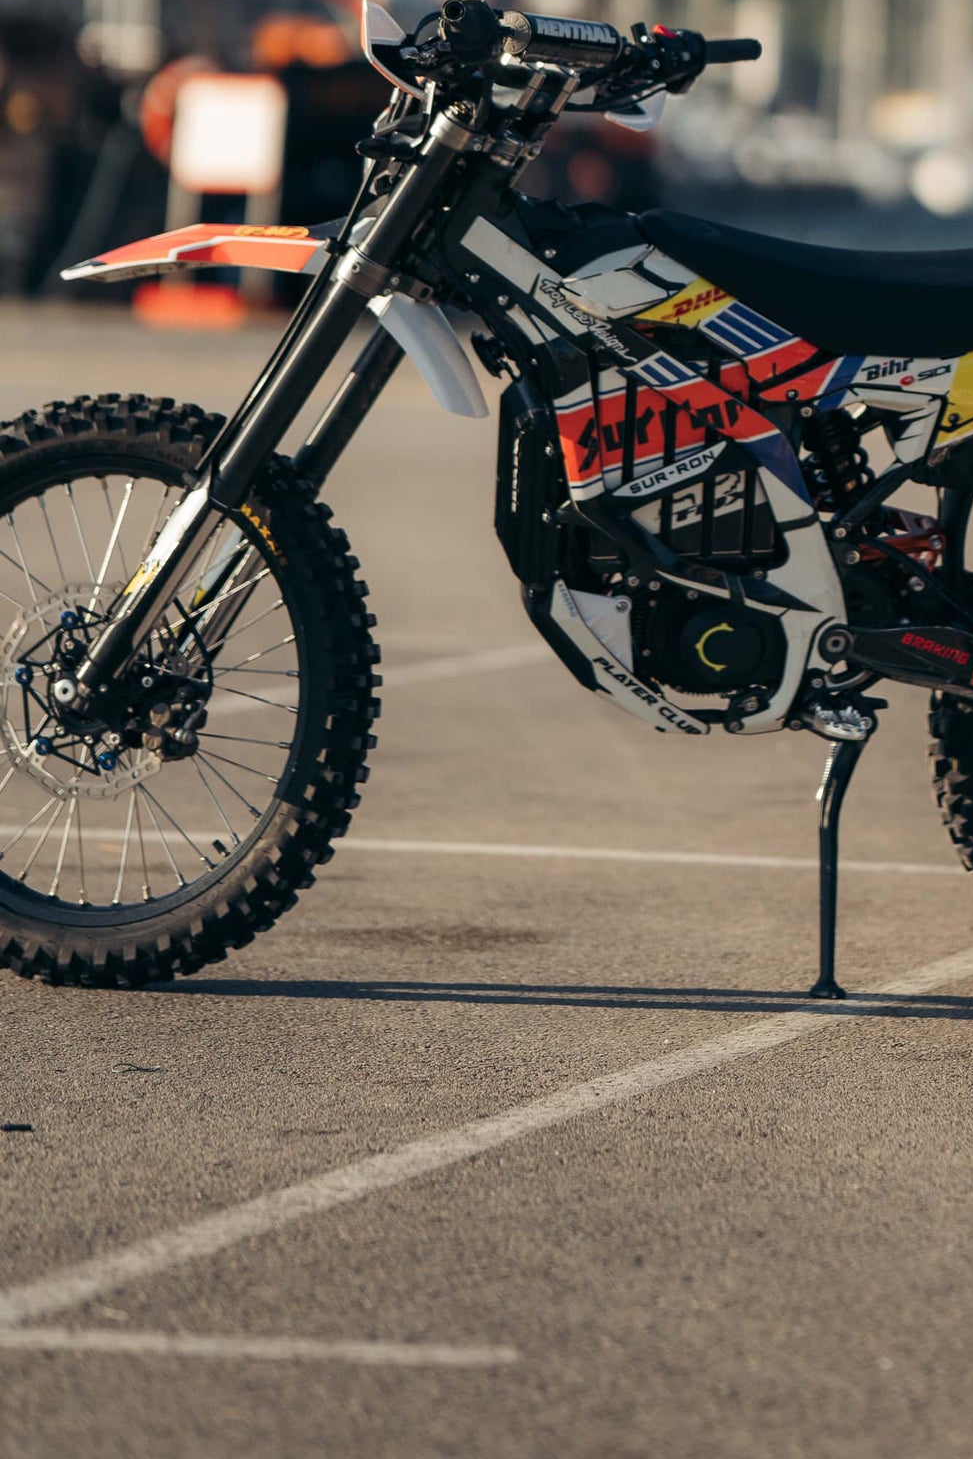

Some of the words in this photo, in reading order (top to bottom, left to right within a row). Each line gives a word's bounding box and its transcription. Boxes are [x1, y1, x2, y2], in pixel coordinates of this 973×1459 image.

[537, 19, 617, 44] RENTHAL
[540, 278, 567, 308] Troy
[565, 301, 593, 328] Lee
[672, 287, 730, 318] DHL
[861, 358, 914, 381] Bihr
[629, 450, 716, 495] SUR-RON
[900, 632, 970, 665] BRAKING
[592, 656, 658, 707] PLAYER
